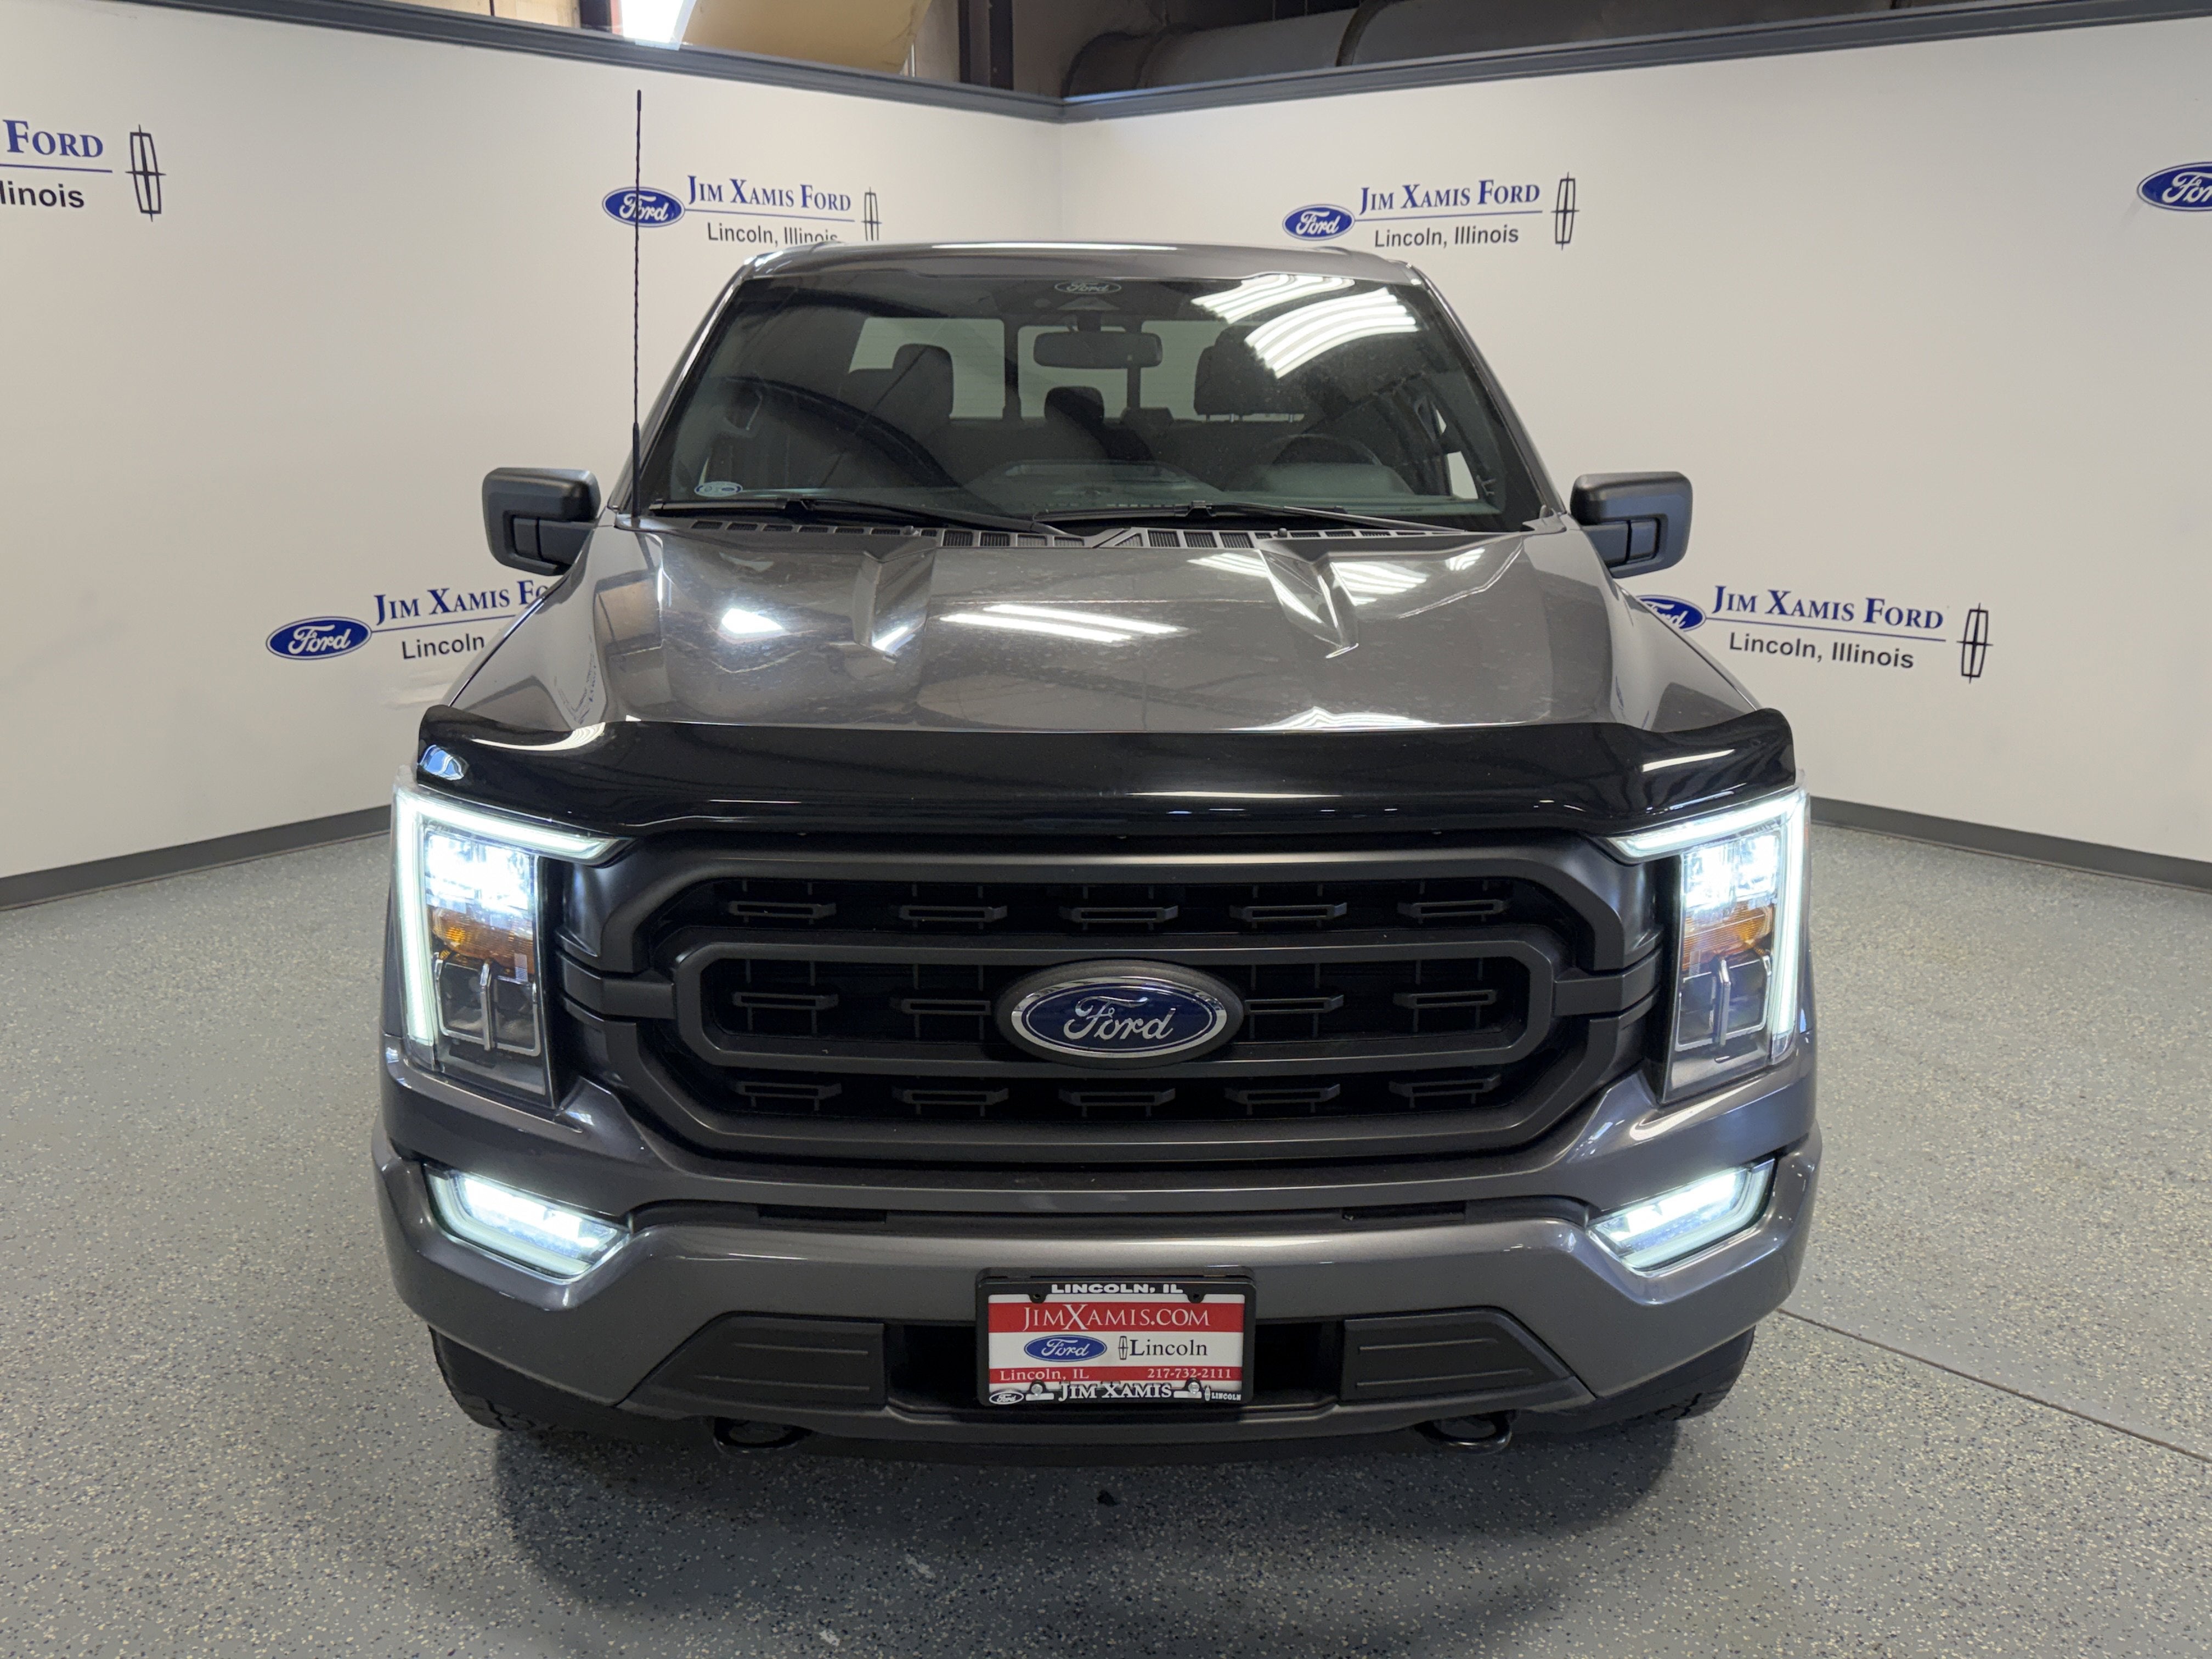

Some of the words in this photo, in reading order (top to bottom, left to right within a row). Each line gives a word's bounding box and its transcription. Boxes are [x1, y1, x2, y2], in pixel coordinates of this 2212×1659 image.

[2, 119, 104, 158] FORD
[0, 180, 84, 208] linois
[687, 175, 723, 205] JIM
[729, 178, 794, 207] XAMIS
[800, 184, 851, 211] FORD
[1359, 187, 1394, 216] JIM
[1400, 184, 1470, 208] XAMIS
[1478, 179, 1541, 205] FORD
[2162, 171, 2212, 203] For
[708, 222, 778, 247] Lincoln,
[1295, 211, 1341, 235] Ford
[1374, 227, 1447, 249] Lincoln,
[1454, 224, 1519, 245] Illinois
[374, 594, 421, 625] JIM
[427, 588, 511, 616] XAMIS
[517, 579, 549, 605] FO
[1711, 585, 1758, 614] JIM
[1764, 589, 1855, 622] XAMIS
[1863, 597, 1944, 629] FORD
[287, 624, 352, 655] Ford
[1729, 632, 1823, 663] Lincoln,
[1832, 641, 1914, 669] Illinois
[1063, 996, 1177, 1041] Ford
[1051, 1284, 1156, 1294] LINCOLN,
[1163, 1284, 1183, 1294] IL
[1040, 1339, 1091, 1357] Ford
[1129, 1339, 1209, 1357] Lincoln
[1000, 1368, 1067, 1381] Lincoln,
[1073, 1368, 1090, 1380] IL
[1147, 1368, 1232, 1379] 217-732-2111
[996, 1393, 1017, 1403] Ford
[1058, 1383, 1098, 1402] JIM
[1101, 1383, 1172, 1399] XAMIS
[1211, 1392, 1242, 1401] LINCOLN
